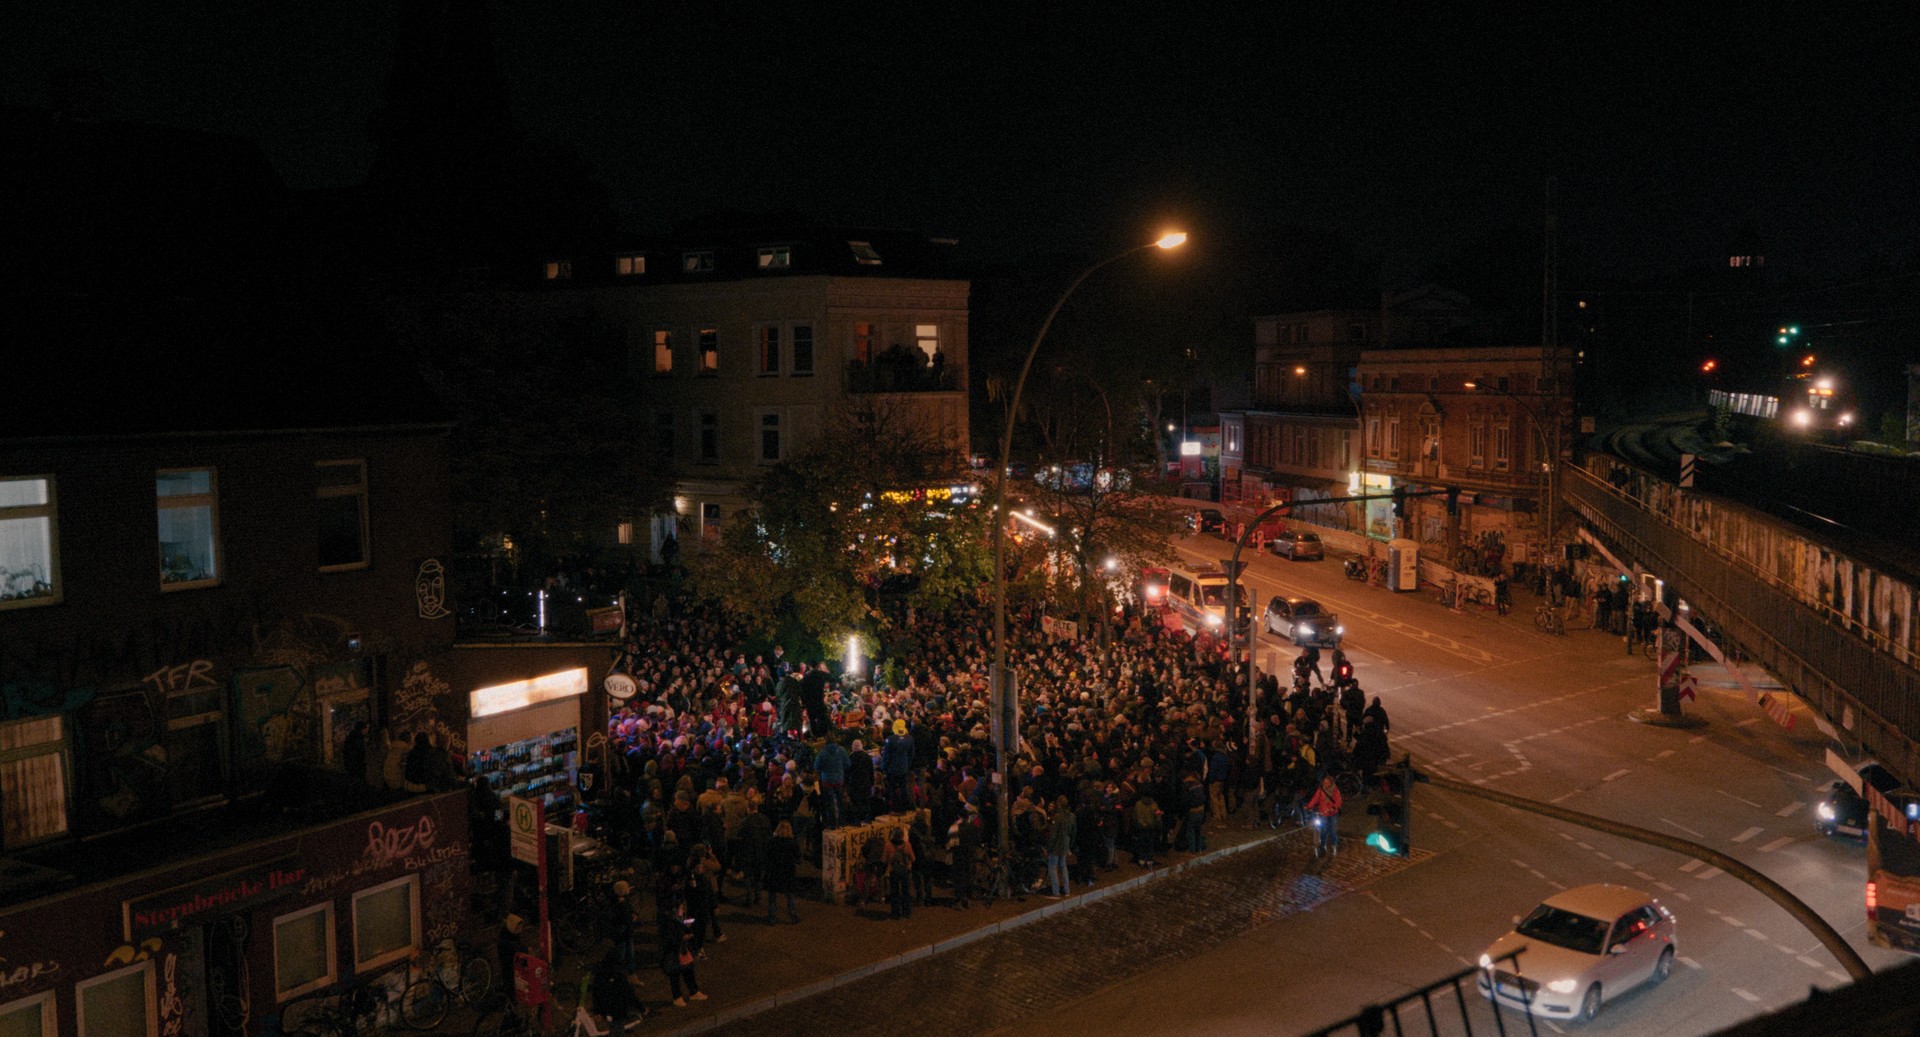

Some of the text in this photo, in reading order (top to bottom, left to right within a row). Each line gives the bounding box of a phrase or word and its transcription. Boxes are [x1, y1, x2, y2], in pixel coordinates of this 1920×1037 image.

[1053, 621, 1071, 631] ALTE
[607, 681, 634, 693] VERO
[520, 808, 528, 826] H
[268, 868, 305, 890] Bar
